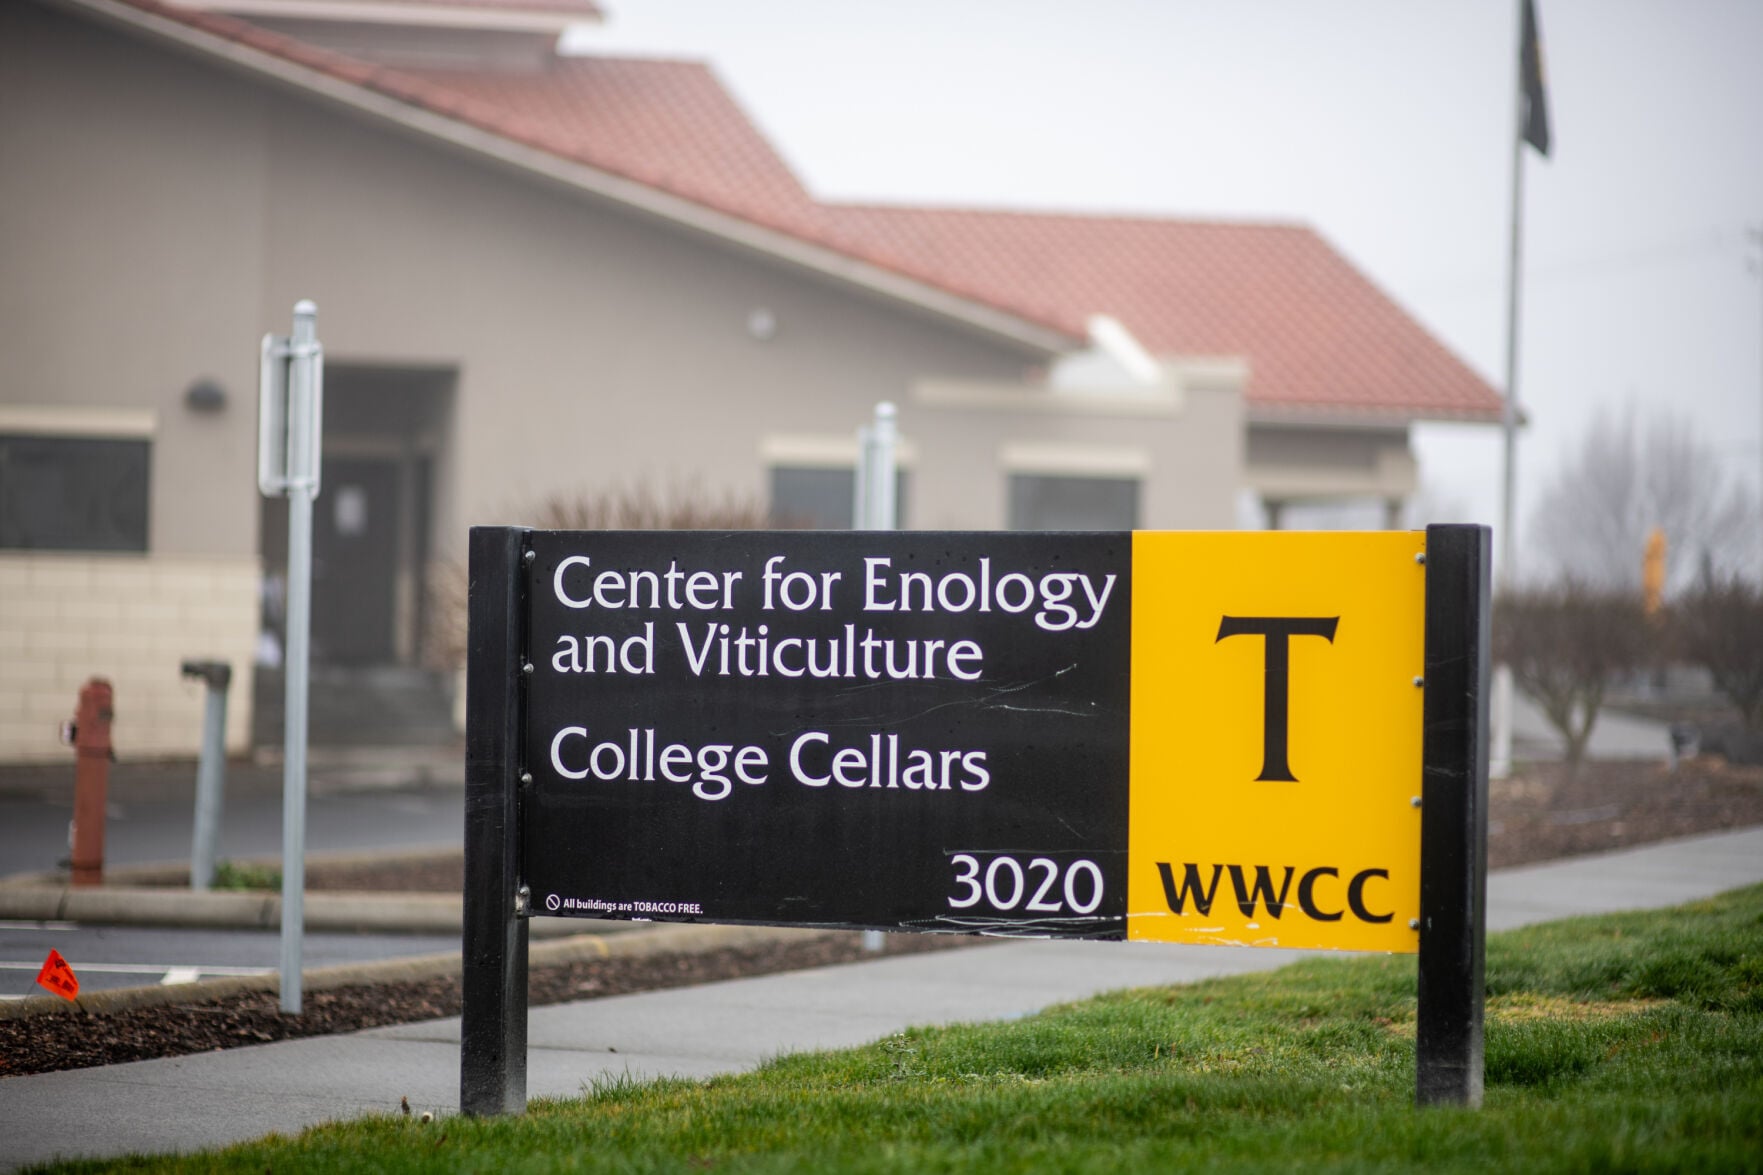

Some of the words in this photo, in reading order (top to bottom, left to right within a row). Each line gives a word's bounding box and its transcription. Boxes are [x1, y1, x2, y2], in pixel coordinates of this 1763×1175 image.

[553, 555, 743, 611] Center
[761, 555, 842, 611] for
[862, 557, 1117, 632] Enology
[551, 621, 656, 675] and
[675, 622, 984, 681] Viticulture
[1215, 615, 1340, 782] T
[550, 725, 769, 801] College
[789, 731, 991, 792] Cellars
[563, 898, 576, 909] All
[576, 898, 617, 913] buildings
[618, 902, 633, 912] are
[633, 901, 677, 913] TOBACCO
[677, 903, 704, 914] FREE.
[947, 853, 1104, 914] 3020
[1156, 862, 1394, 924] WWCC
